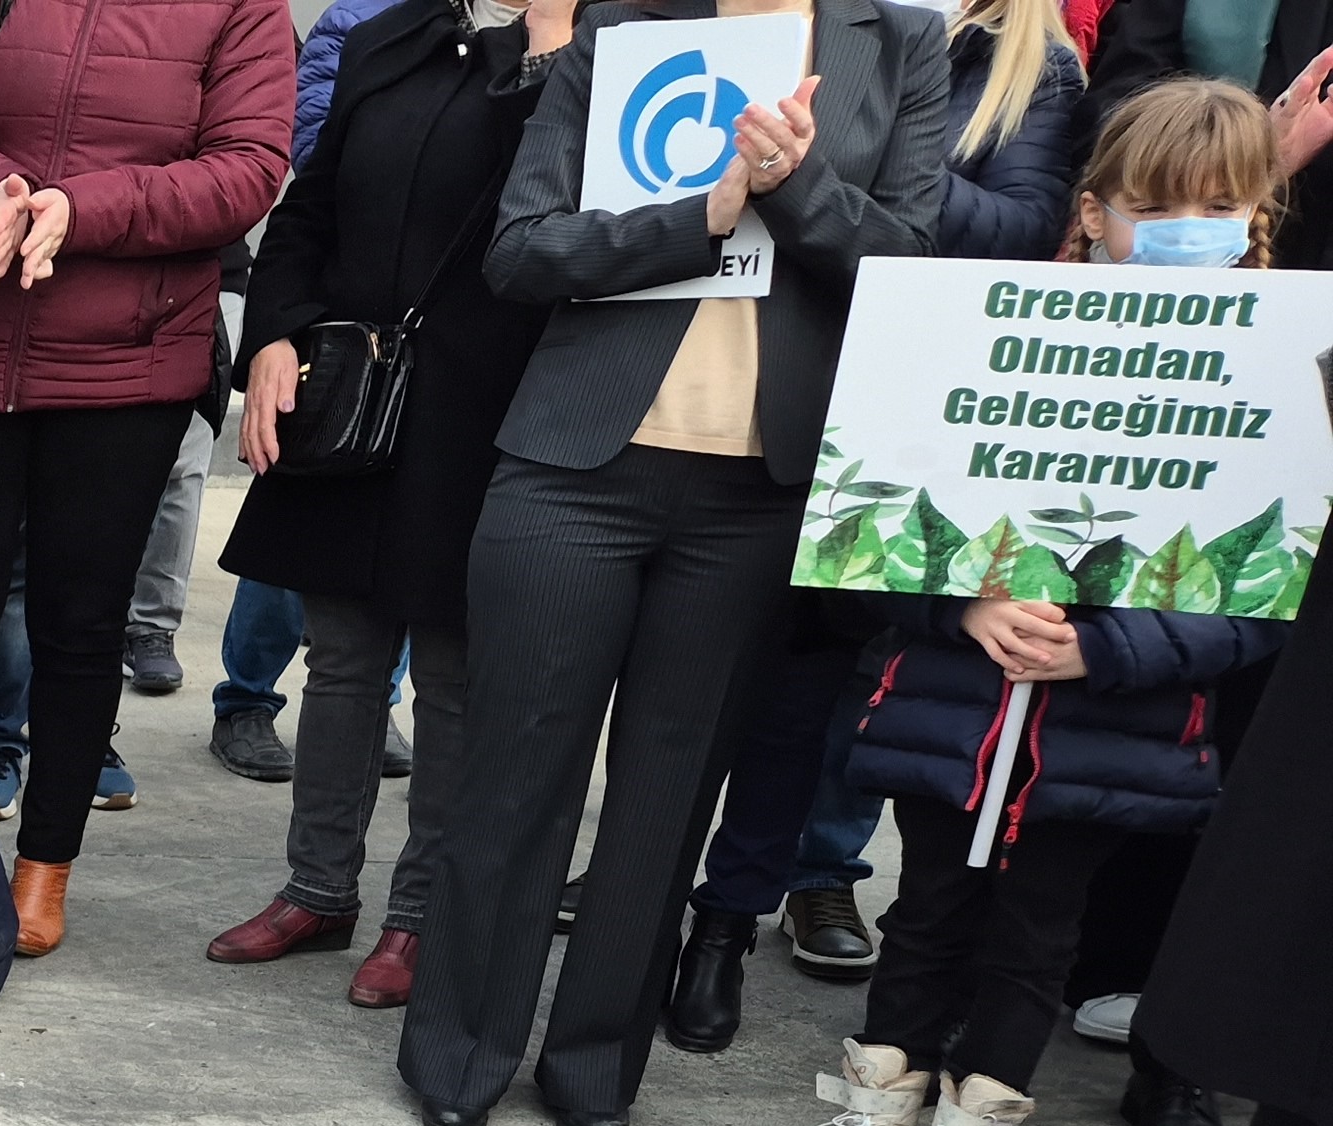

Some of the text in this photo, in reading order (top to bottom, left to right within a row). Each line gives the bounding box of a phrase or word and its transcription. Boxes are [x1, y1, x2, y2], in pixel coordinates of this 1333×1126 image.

[984, 280, 1260, 328] Greenport
[988, 335, 1233, 387] Olmadan,
[943, 386, 1273, 439] Geleceğimiz
[967, 442, 1219, 490] Kararıyor
